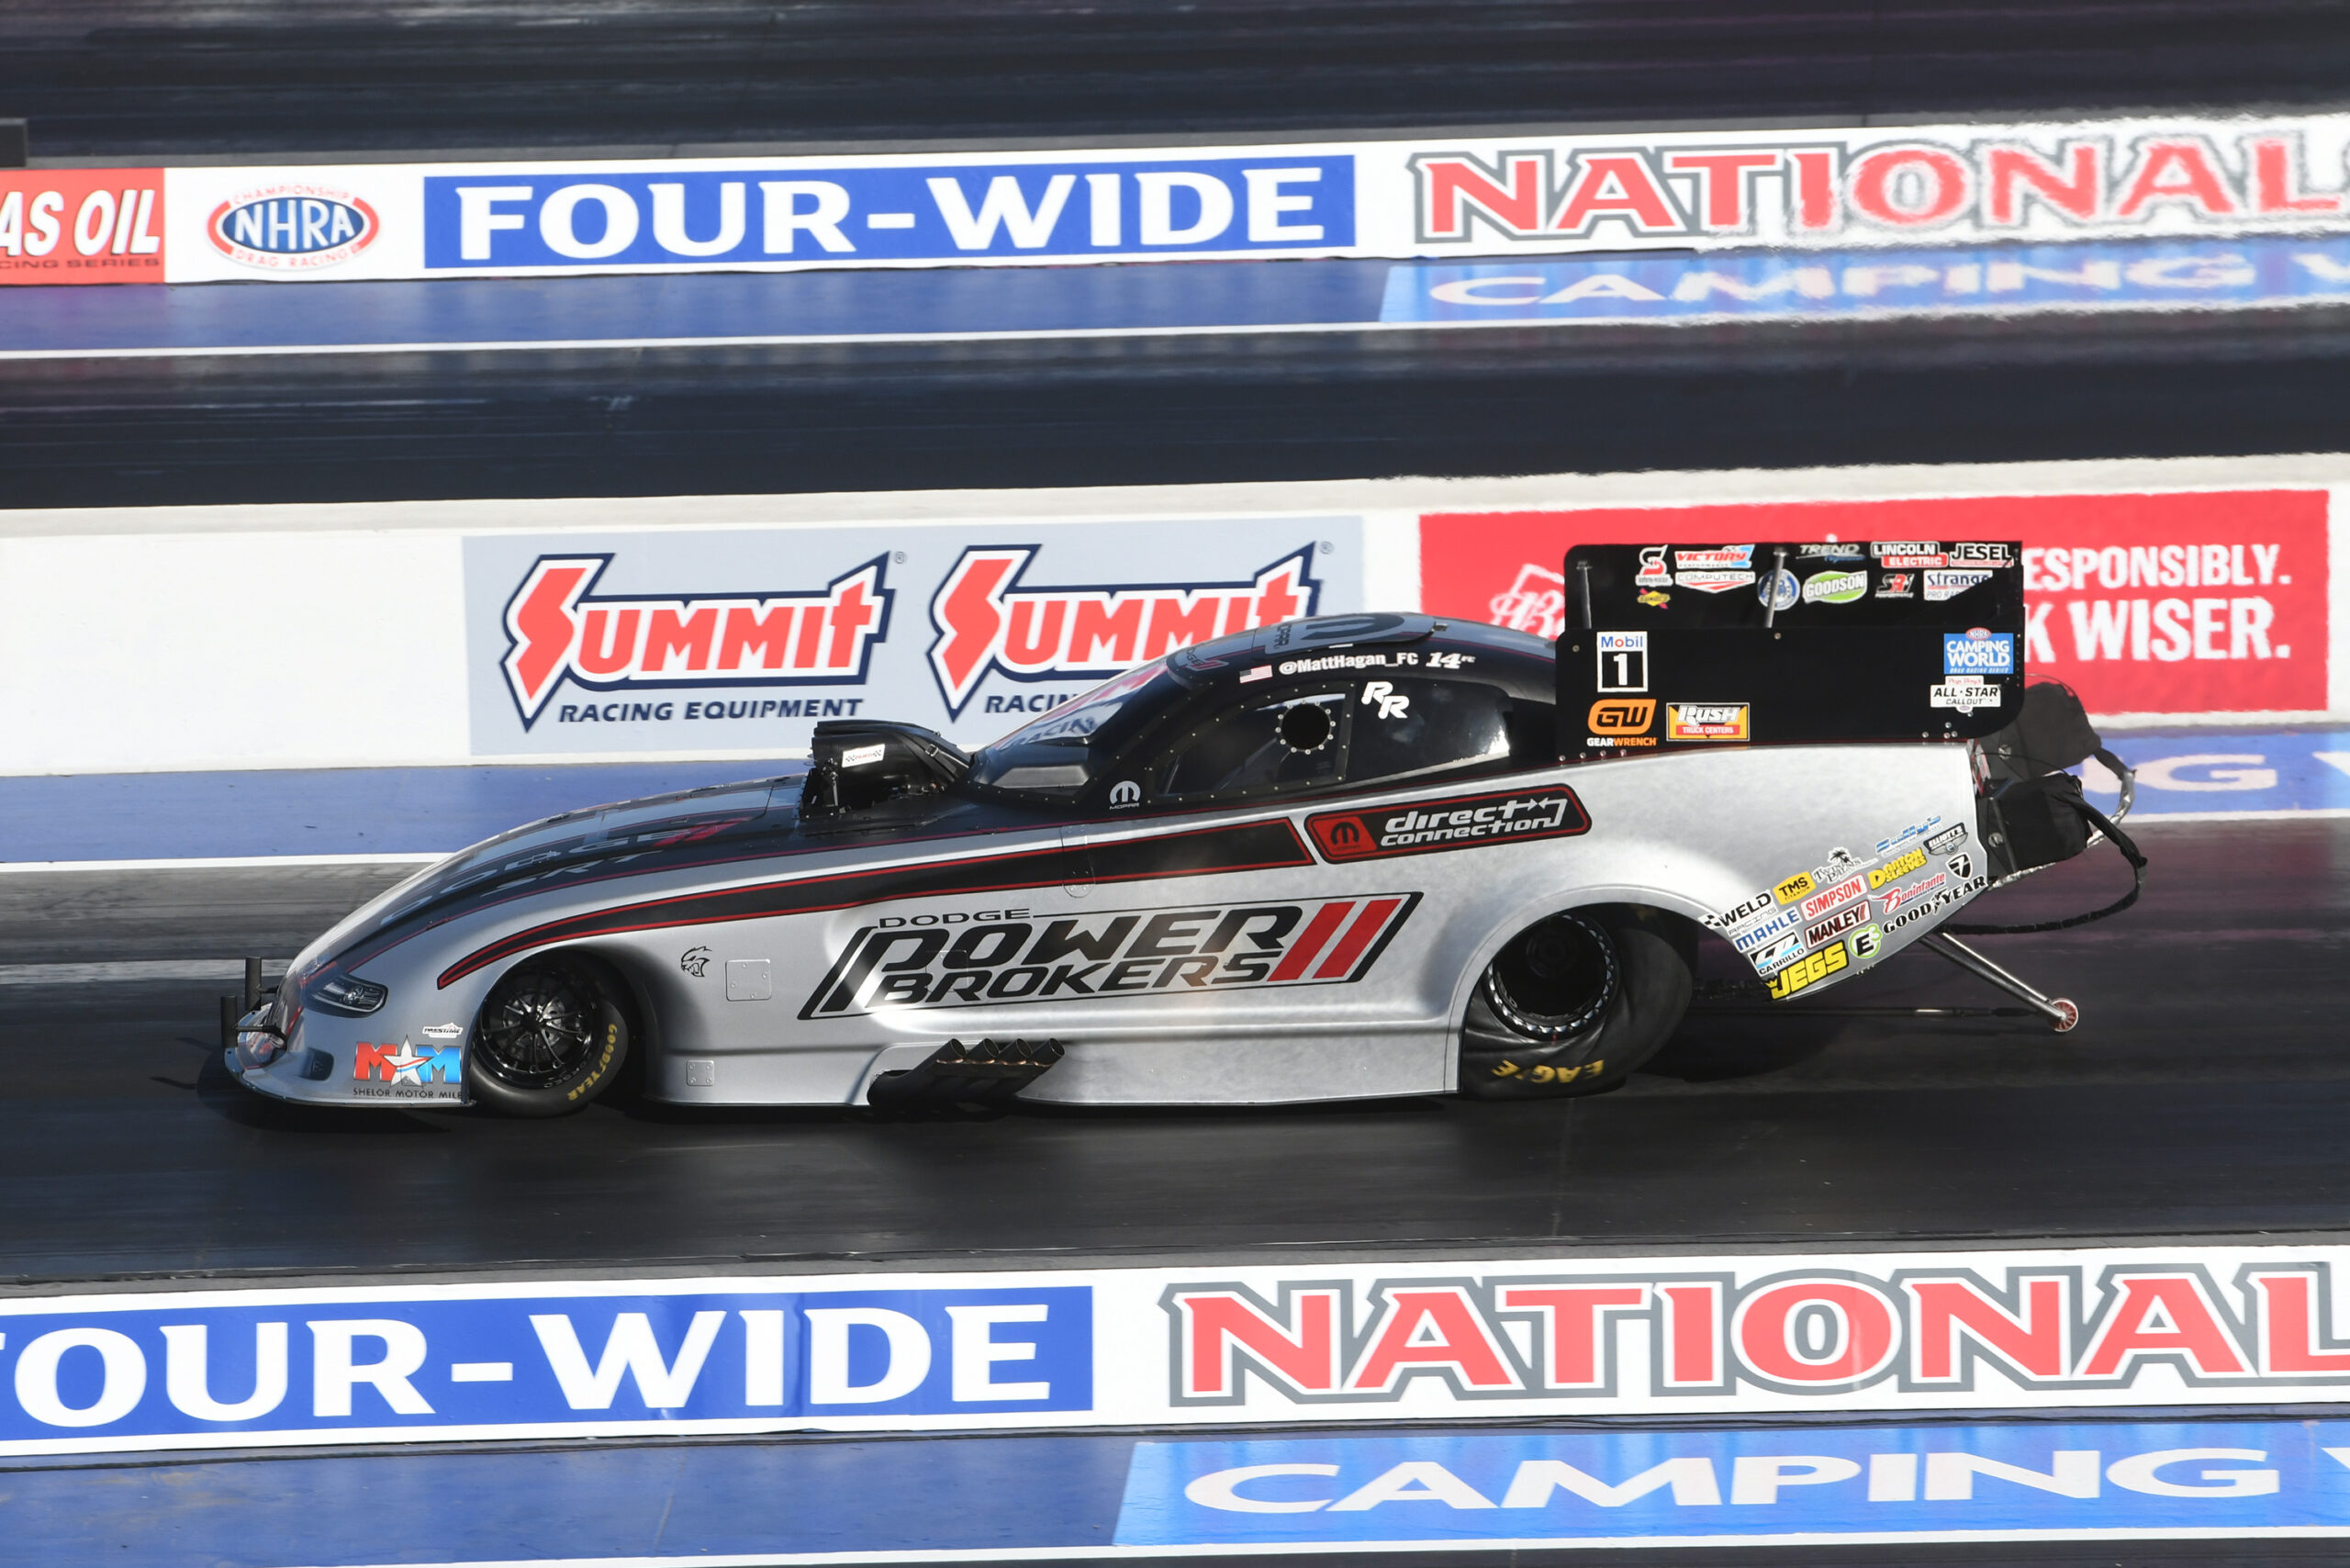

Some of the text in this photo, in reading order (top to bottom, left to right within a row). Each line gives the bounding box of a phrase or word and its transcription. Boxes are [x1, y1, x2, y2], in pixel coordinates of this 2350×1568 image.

[232, 185, 350, 204] CHAMPIONSHIP
[1416, 134, 2350, 237] NATIONAL
[73, 189, 162, 256] OIL
[234, 199, 355, 250] NHRA
[455, 167, 1324, 261] FOUR-WIDE
[0, 258, 160, 269] CING SERIES
[235, 248, 349, 267] DRAG RACING
[1428, 254, 2255, 307] CAMPING
[1676, 552, 1747, 562] VICTORY
[1800, 543, 1860, 554] TREND
[1874, 543, 1936, 555] LINCOLN
[1951, 543, 2011, 561] JESEL
[1888, 556, 1942, 566] ELECTRIC
[2022, 543, 2291, 591] ESPONSIBLY.
[1677, 573, 1754, 581] COMPUTECH
[1805, 574, 1865, 597] GOODSON
[2067, 596, 2291, 662] WISER.
[1601, 635, 1643, 648] Mobil
[1946, 641, 2010, 653] CAMPING
[1279, 653, 1418, 676] @MattHagan_FC
[1613, 653, 1628, 686] 1
[1946, 652, 2010, 666] WORLD
[559, 698, 864, 722] RACING EQUIPMENT
[985, 693, 1079, 713] RACIN
[1596, 706, 1648, 727] GW
[1683, 726, 1734, 734] TRUCK CENTERS
[1586, 737, 1657, 747] GEARWRENCH
[1109, 801, 1140, 811] MOPAR
[1385, 797, 1528, 833] direct
[1381, 817, 1562, 846] connection
[1779, 877, 1808, 897] TMS
[1785, 886, 1810, 901] TITANIUM
[1805, 879, 1863, 917] SIMPSON
[878, 907, 1031, 928] DODGE
[1719, 892, 1772, 927] WELD
[1728, 908, 1777, 935] RACING
[1735, 909, 1800, 951] MAHLE
[1808, 906, 1861, 946] MANLEY
[858, 906, 1303, 972] POWER
[1759, 948, 1805, 975] CARRILLO
[1771, 941, 1848, 1000] JEGS
[879, 952, 1282, 1002] BROKERS
[1491, 1058, 1605, 1084] EAGE
[352, 1088, 390, 1098] SHELOR
[396, 1090, 434, 1099] MOTOR
[0, 1304, 1049, 1428] OUR-WIDE
[1184, 1448, 2281, 1514] CAMPING
